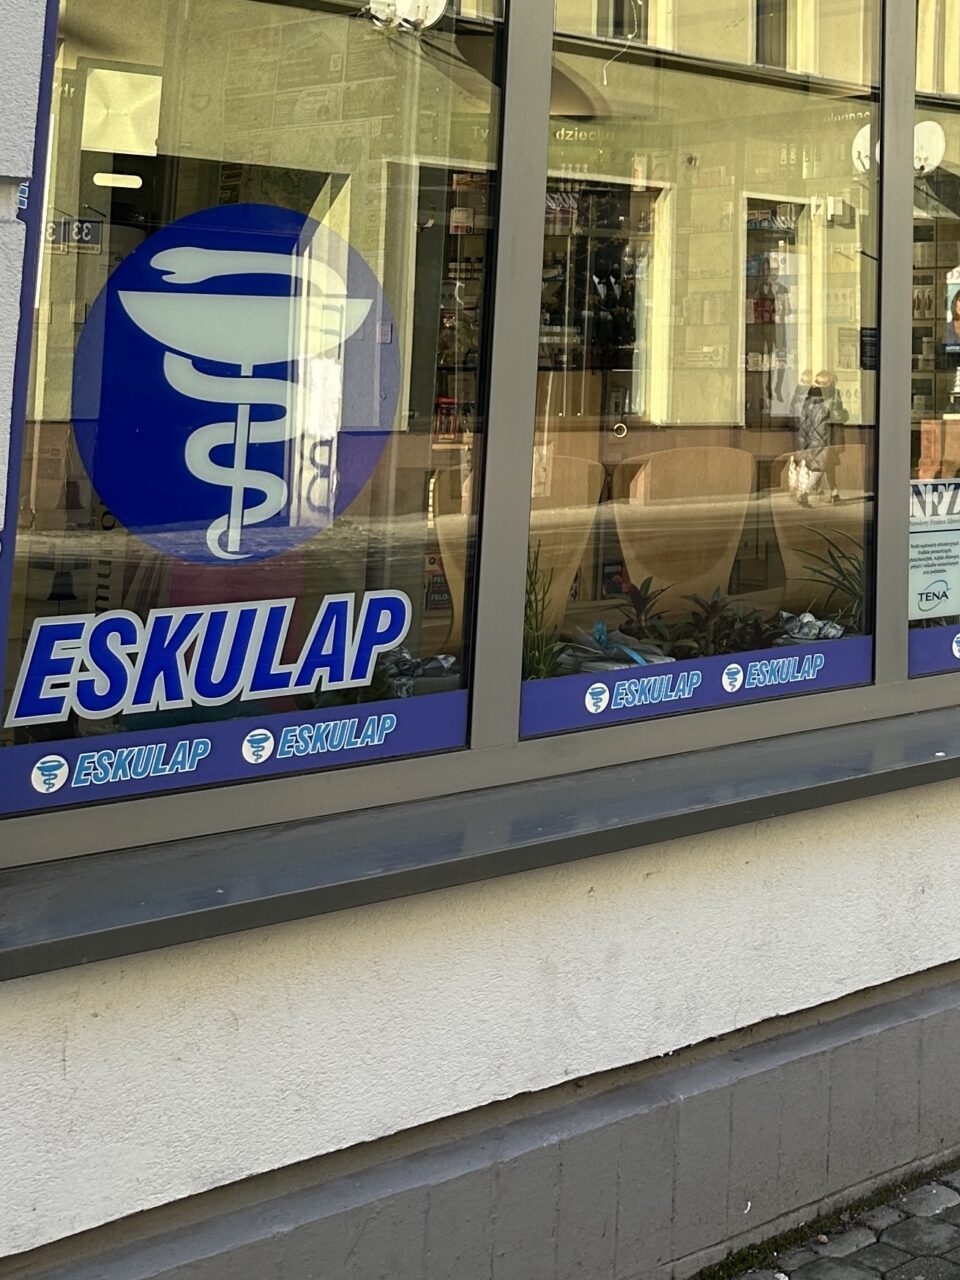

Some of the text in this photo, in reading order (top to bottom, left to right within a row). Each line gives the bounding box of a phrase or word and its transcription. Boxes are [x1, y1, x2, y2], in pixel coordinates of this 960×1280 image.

[918, 591, 949, 602] TENA
[4, 589, 413, 729] ESKULAP
[745, 653, 825, 689] ESKULAP
[611, 670, 702, 709] ESKULAP
[276, 713, 397, 758] ESKULAP
[71, 738, 211, 787] ESKULAP
